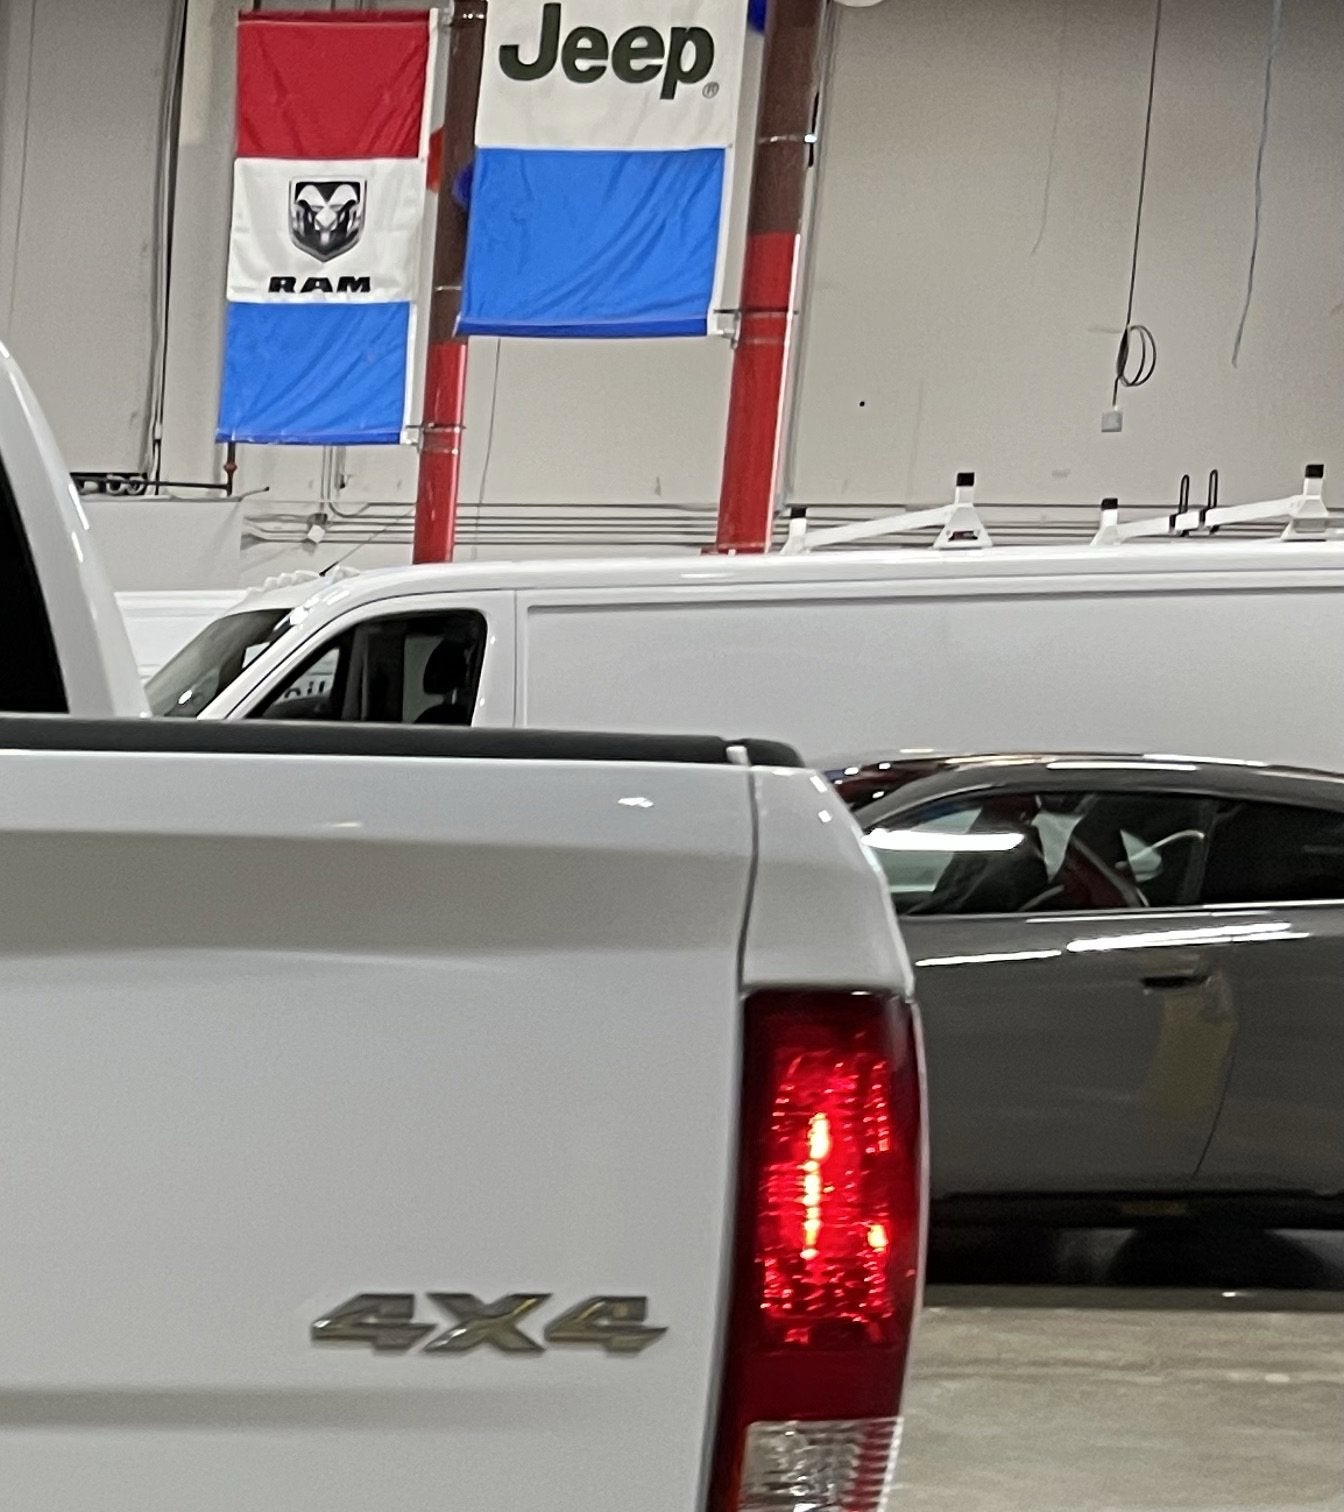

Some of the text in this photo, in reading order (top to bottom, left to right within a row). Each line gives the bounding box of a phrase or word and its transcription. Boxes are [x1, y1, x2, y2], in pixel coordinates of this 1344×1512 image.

[499, 3, 715, 100] Jeep
[268, 275, 371, 294] RAM
[311, 1292, 669, 1353] 4X4
